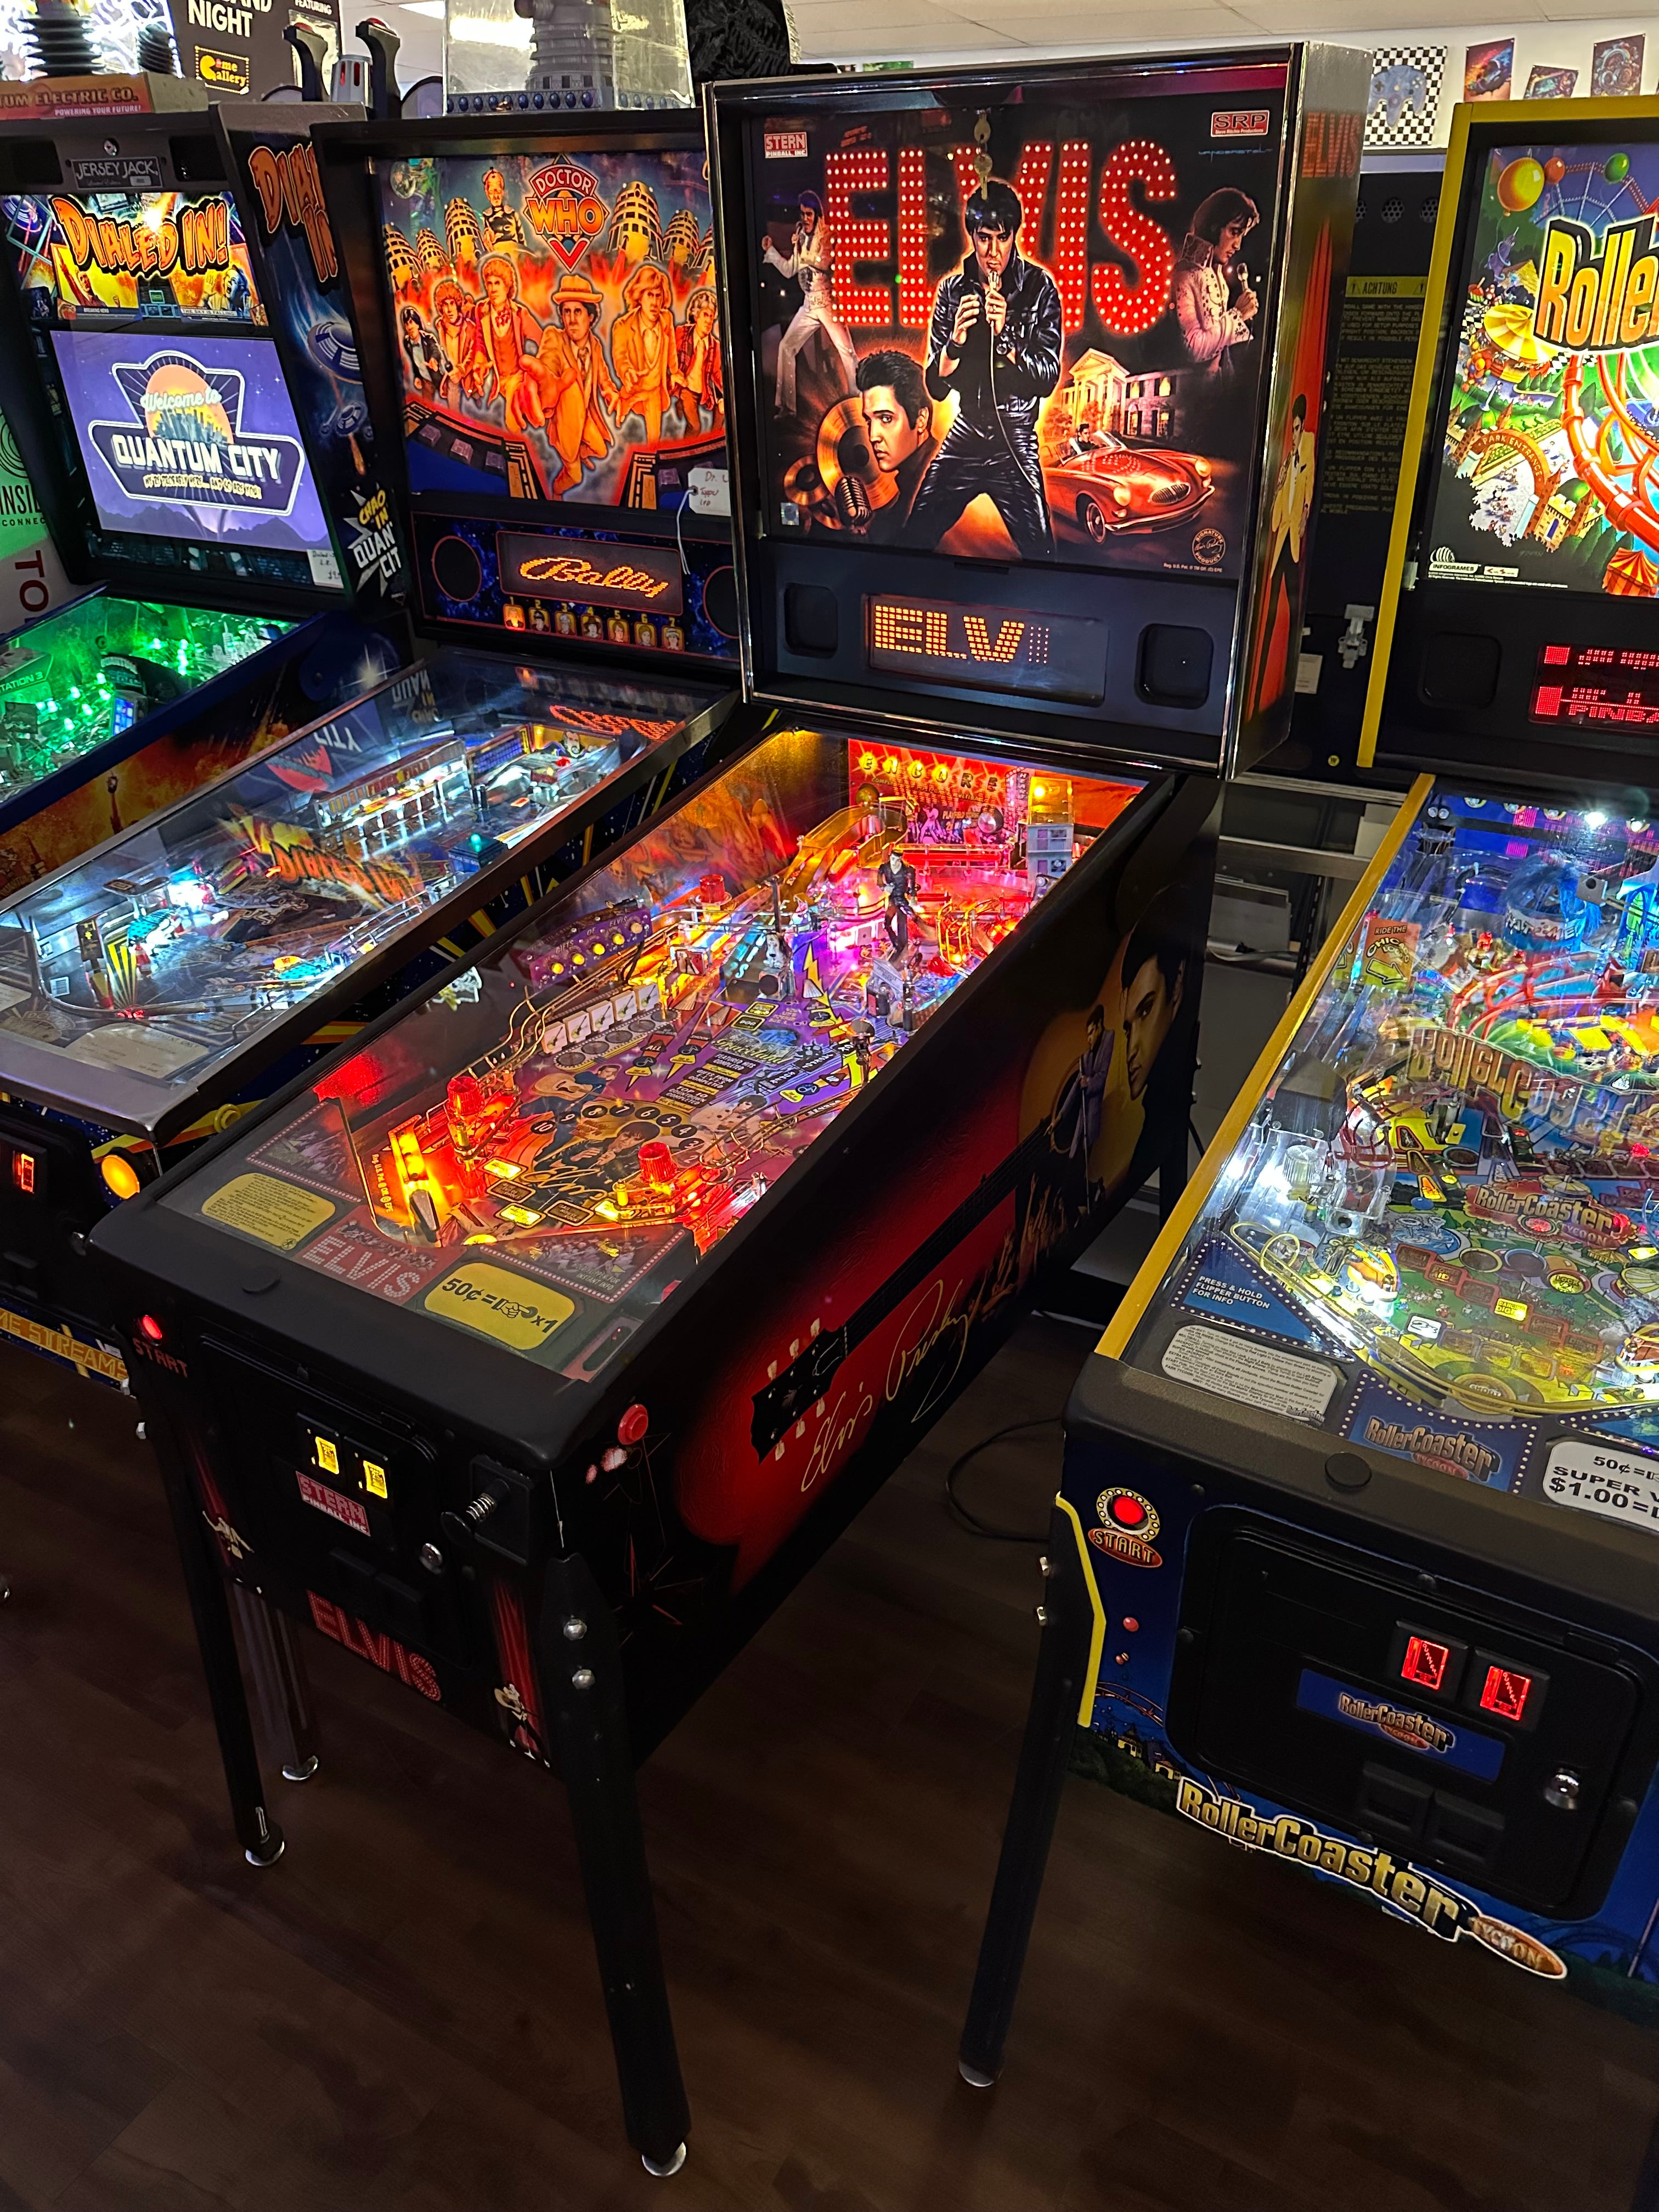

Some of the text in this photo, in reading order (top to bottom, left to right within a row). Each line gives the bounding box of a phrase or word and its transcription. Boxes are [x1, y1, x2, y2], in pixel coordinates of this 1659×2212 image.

[295, 0, 332, 15] FEATURING
[188, 0, 253, 37] NIGHT
[35, 87, 138, 106] ELECTRIC CO.
[55, 104, 142, 116] POWERING YOUR FUTURE!
[1214, 113, 1267, 128] SRP
[766, 133, 806, 150] STERN
[1302, 111, 1361, 178] ELVIS
[75, 160, 159, 180] JERSEY JACK
[536, 166, 595, 194] DOCTOR
[526, 195, 605, 235] WHO
[52, 196, 229, 272] DIALED IN!
[825, 138, 1178, 335] ELVIS
[1362, 281, 1398, 295] ACHTUNG
[1538, 226, 1659, 348] Rolle
[140, 386, 222, 412] Welcome to
[111, 434, 281, 480] QUANTUM CITY
[1482, 435, 1543, 476] PARK ENTRANCE
[375, 506, 389, 530] IN
[1195, 529, 1224, 544] SIGNATURE
[1195, 552, 1221, 564] PRODUCT
[1433, 563, 1475, 572] INFOGRAMES
[520, 557, 669, 599] Bally
[510, 597, 514, 605] 1
[562, 603, 568, 611] 3
[588, 606, 594, 615] 4
[614, 610, 621, 619] 5
[641, 614, 648, 623] 6
[669, 618, 675, 626] 7
[34, 671, 43, 681] 3
[862, 753, 997, 793] ENCORE
[610, 916, 628, 927] ELVIS
[586, 927, 596, 936] OF
[1375, 925, 1407, 935] RIDE THE
[555, 939, 574, 955] GIFTS
[713, 1058, 744, 1071] COMPLETED
[714, 1053, 757, 1069] FEATURED HITS
[688, 1075, 724, 1089] COMPLETED
[696, 1069, 715, 1077] GIFTS
[716, 1074, 735, 1084] FROM
[665, 1092, 701, 1105] COMPLETED
[668, 1088, 707, 1103] COUNTDOWN
[675, 1086, 709, 1098] TOP 10
[560, 1113, 575, 1122] 9
[587, 1107, 602, 1116] 8
[617, 1105, 630, 1114] 7
[640, 1109, 654, 1118] 6
[534, 1121, 554, 1133] 10
[662, 1116, 676, 1124] 5
[679, 1126, 692, 1136] 4
[684, 1142, 700, 1150] 3
[1476, 1186, 1612, 1237] RollerCoaster
[1561, 1222, 1609, 1244] TYCOON
[302, 1234, 421, 1299] ELVIS
[576, 1273, 615, 1291] INSTANT INFO
[1199, 1276, 1228, 1289] PRESS
[1237, 1286, 1263, 1300] HOLD
[1554, 1274, 1583, 1288] LOCK
[1192, 1288, 1234, 1306] FOR INFO
[1195, 1282, 1271, 1310] FLIPPER BUTTON
[530, 1314, 559, 1334] x1
[132, 1338, 188, 1379] START
[1365, 1417, 1493, 1477] RollerCoaster
[1414, 1452, 1458, 1476] TYCOON
[1553, 1465, 1640, 1497] SUPER
[300, 1476, 366, 1526] STERN
[1093, 1530, 1154, 1565] START
[306, 1590, 442, 1701] ELVIS
[1340, 1694, 1448, 1748] RollerCoaster
[1180, 1782, 1459, 1931] RollerCoaster
[1473, 1921, 1548, 1968] TYCOON
